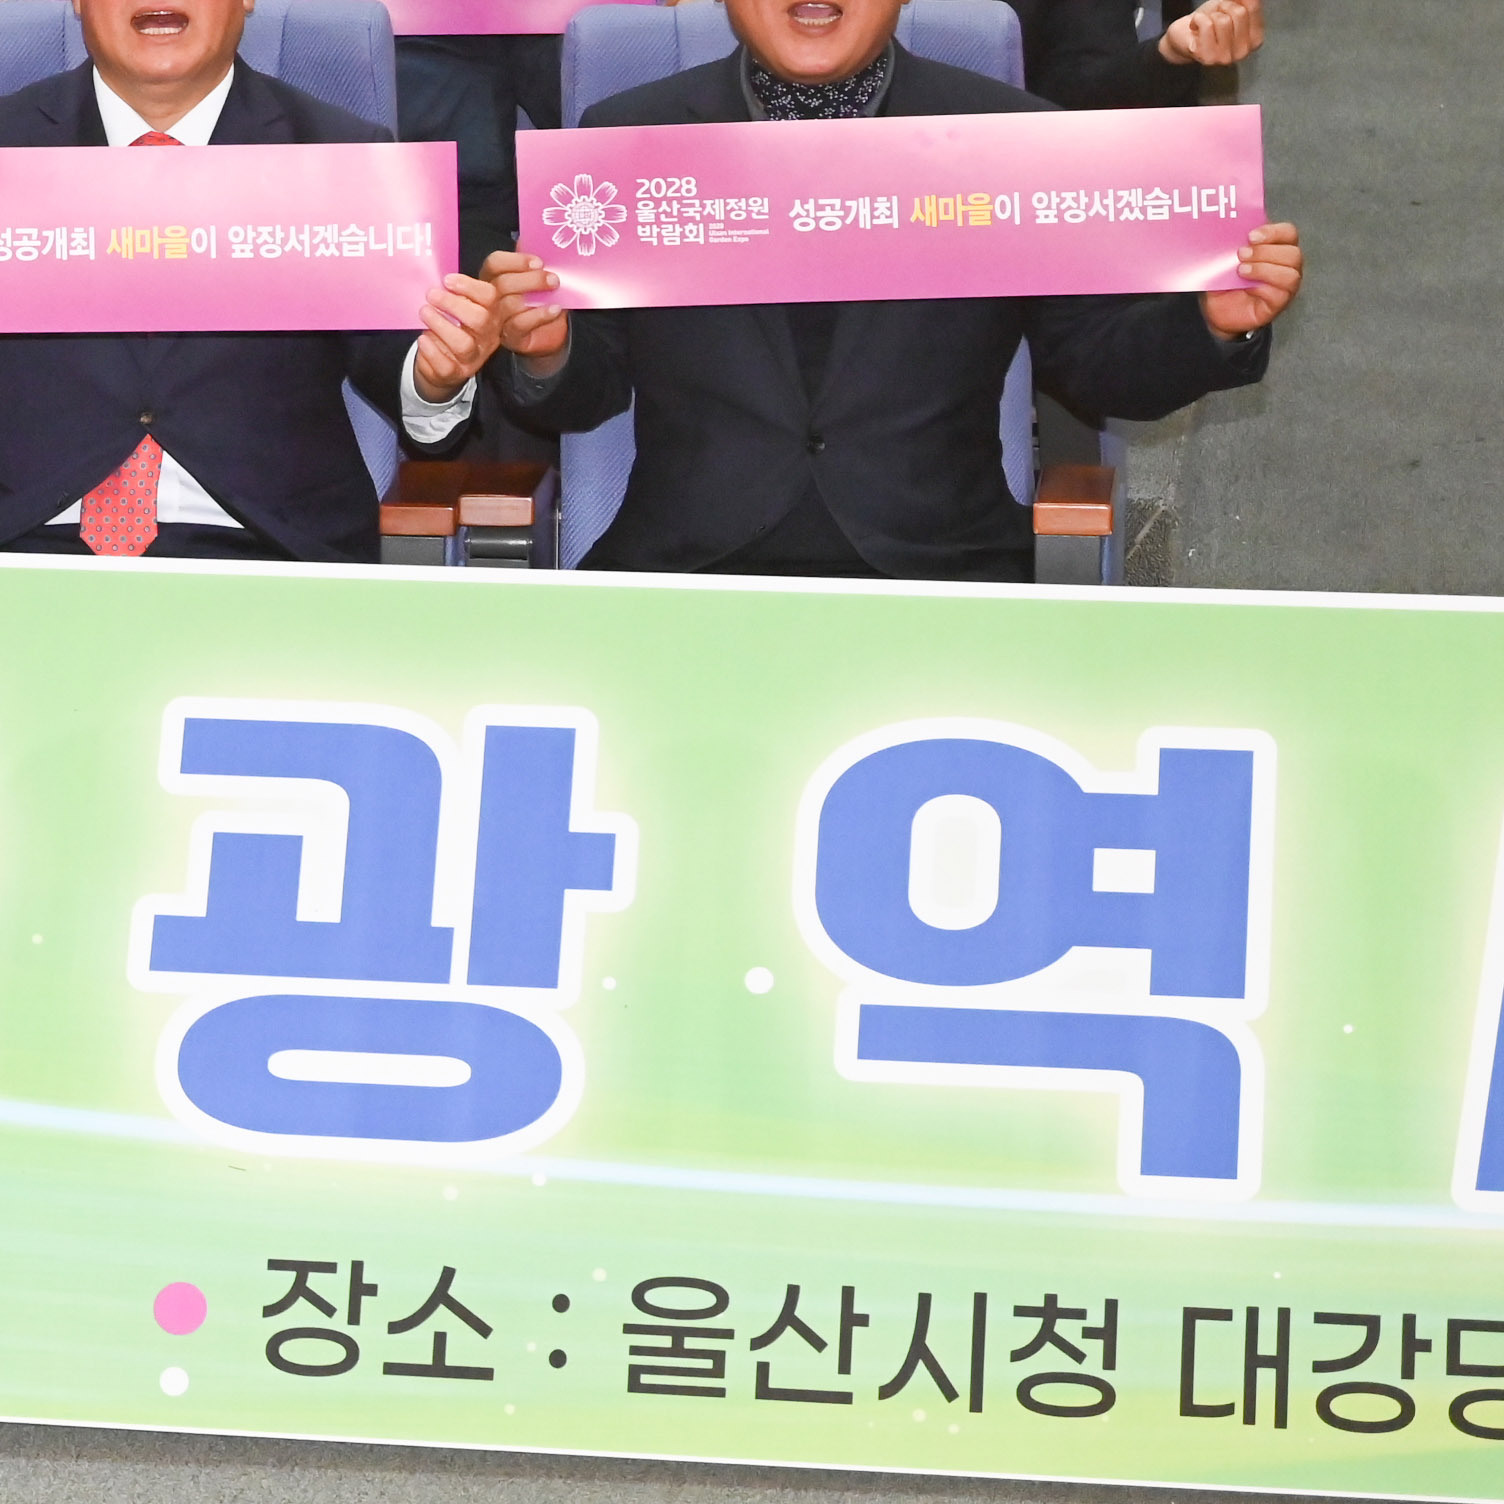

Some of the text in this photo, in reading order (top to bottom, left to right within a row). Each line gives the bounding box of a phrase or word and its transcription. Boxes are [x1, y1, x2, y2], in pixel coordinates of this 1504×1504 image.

[637, 176, 697, 198] 2028
[636, 197, 769, 223] 울산국제정원
[788, 184, 1237, 232] 성공개최 새마을이 앞장서겠습니다!
[106, 225, 217, 260] 새마을이
[228, 222, 432, 259] 앞장서겠습니다!
[638, 222, 705, 246] 박람회
[262, 1258, 495, 1381] 장소
[622, 1276, 1119, 1418] 울산시청
